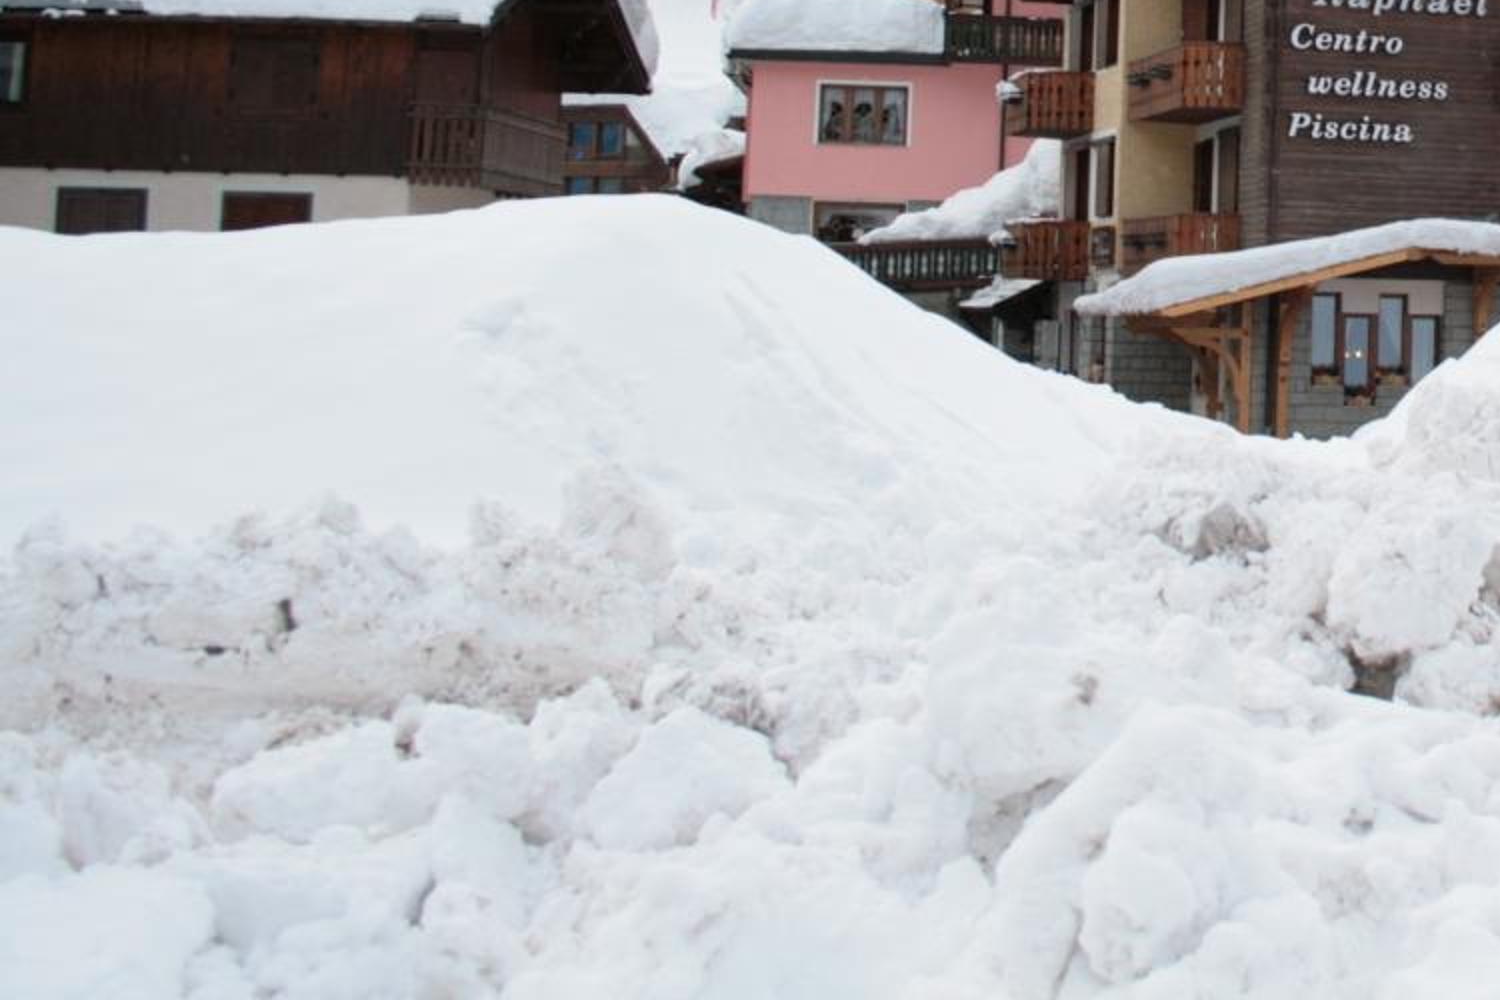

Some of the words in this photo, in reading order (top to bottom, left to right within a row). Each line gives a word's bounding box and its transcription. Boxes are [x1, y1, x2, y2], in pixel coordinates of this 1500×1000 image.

[1290, 23, 1403, 54] Centro
[1308, 71, 1449, 100] wellness
[1288, 112, 1414, 143] Piscina
